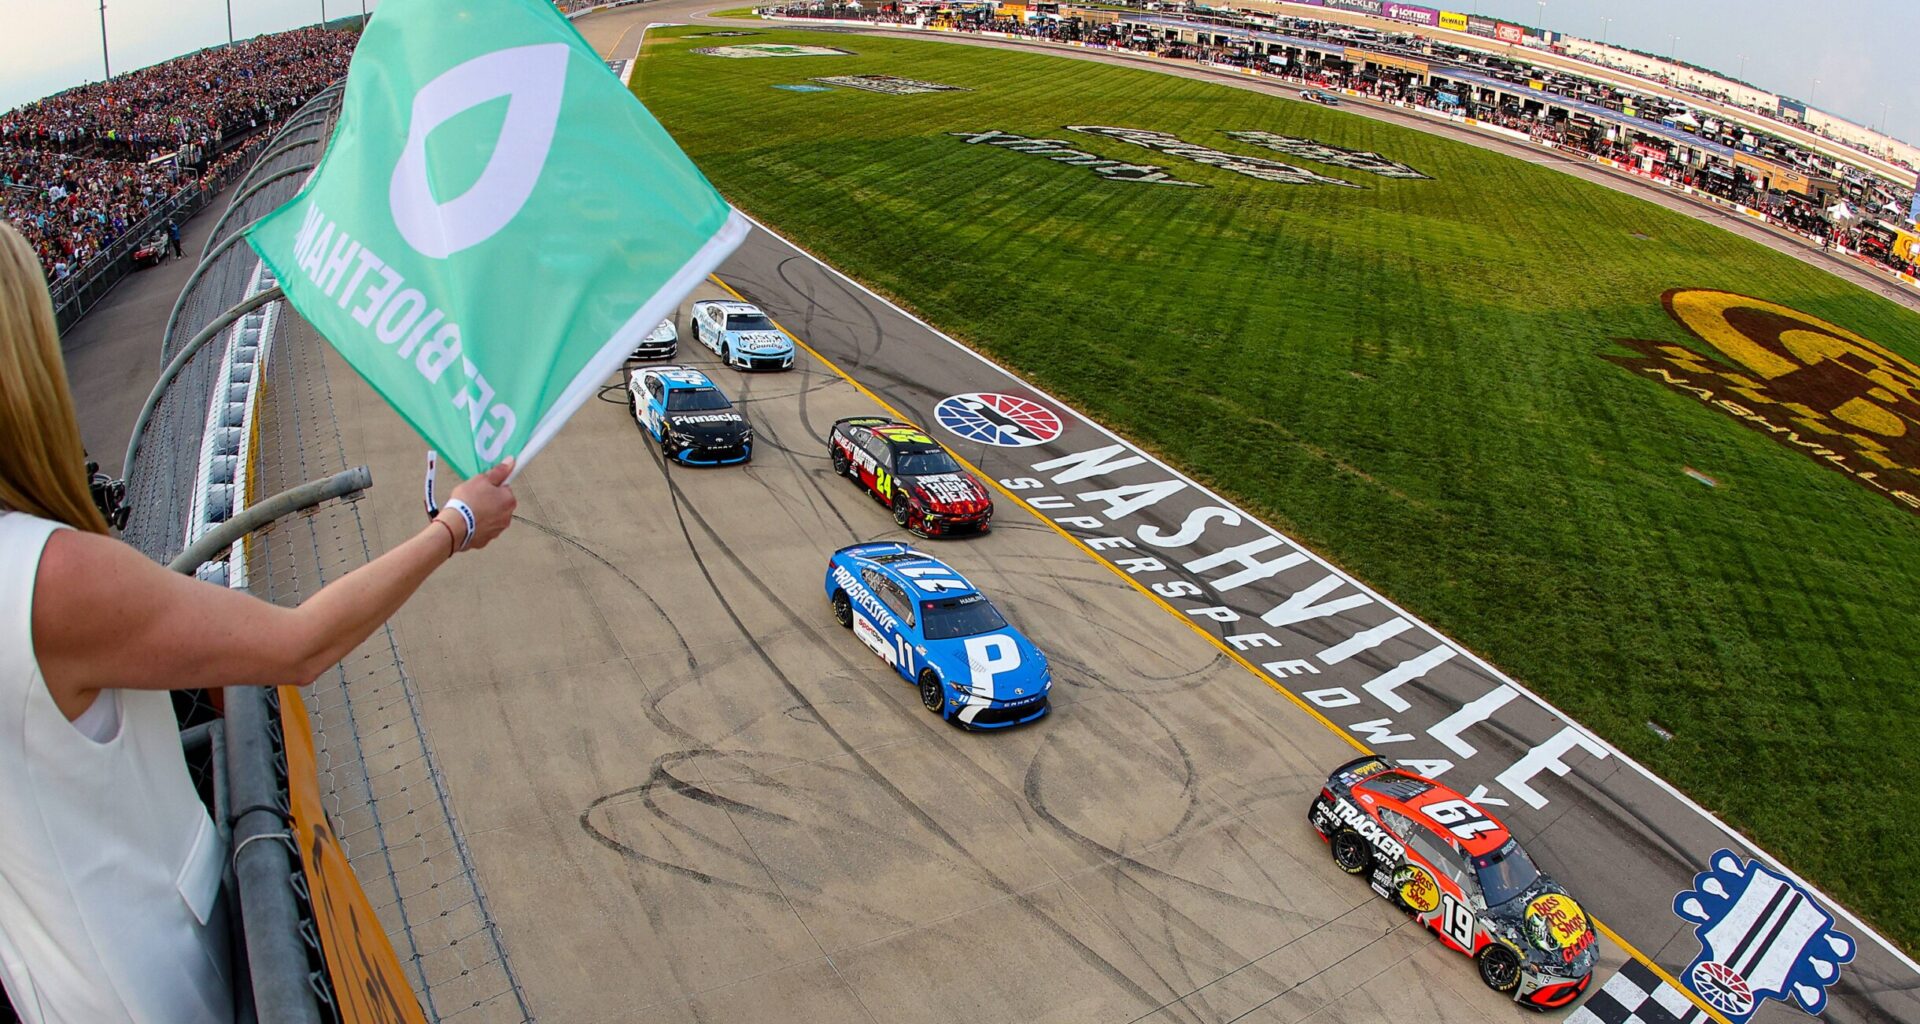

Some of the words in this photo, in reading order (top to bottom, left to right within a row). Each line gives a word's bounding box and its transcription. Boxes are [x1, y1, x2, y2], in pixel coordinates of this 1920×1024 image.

[671, 412, 743, 426] Pinnacle
[876, 467, 892, 500] 24
[926, 481, 972, 494] HIGH
[936, 490, 977, 504] HEAT
[831, 564, 899, 634] PROGRESSIVE
[1031, 443, 1612, 812] NASHVILLE
[895, 633, 916, 678] 11
[1000, 476, 1510, 808] SUPERSPEEDWAY
[1316, 800, 1342, 828] BOATS
[1420, 799, 1501, 840] 19
[1333, 797, 1406, 862] TRACKER
[1410, 880, 1426, 896] Pro
[1414, 869, 1434, 892] Bass
[1406, 889, 1431, 912] Shops
[1531, 896, 1560, 917] Bass
[1443, 893, 1475, 951] 19
[1545, 908, 1568, 928] Pro
[1556, 913, 1586, 940] Shops
[1561, 929, 1597, 965] CLUB
